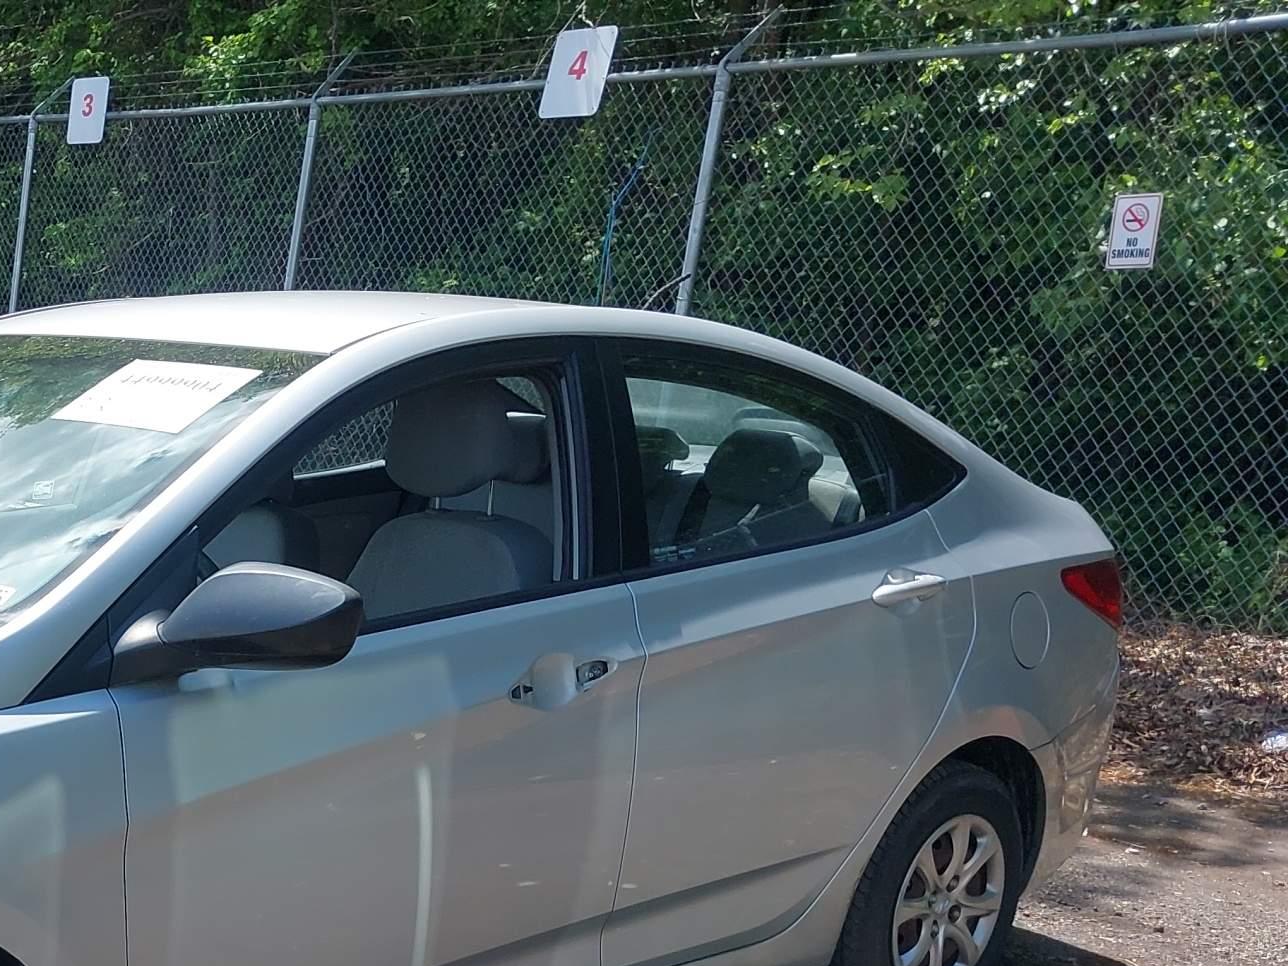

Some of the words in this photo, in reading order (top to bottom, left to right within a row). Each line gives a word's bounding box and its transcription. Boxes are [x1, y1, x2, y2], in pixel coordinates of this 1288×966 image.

[568, 50, 588, 80] 4
[81, 93, 95, 118] 3
[1126, 237, 1138, 247] NO
[1111, 247, 1151, 259] SMOKING
